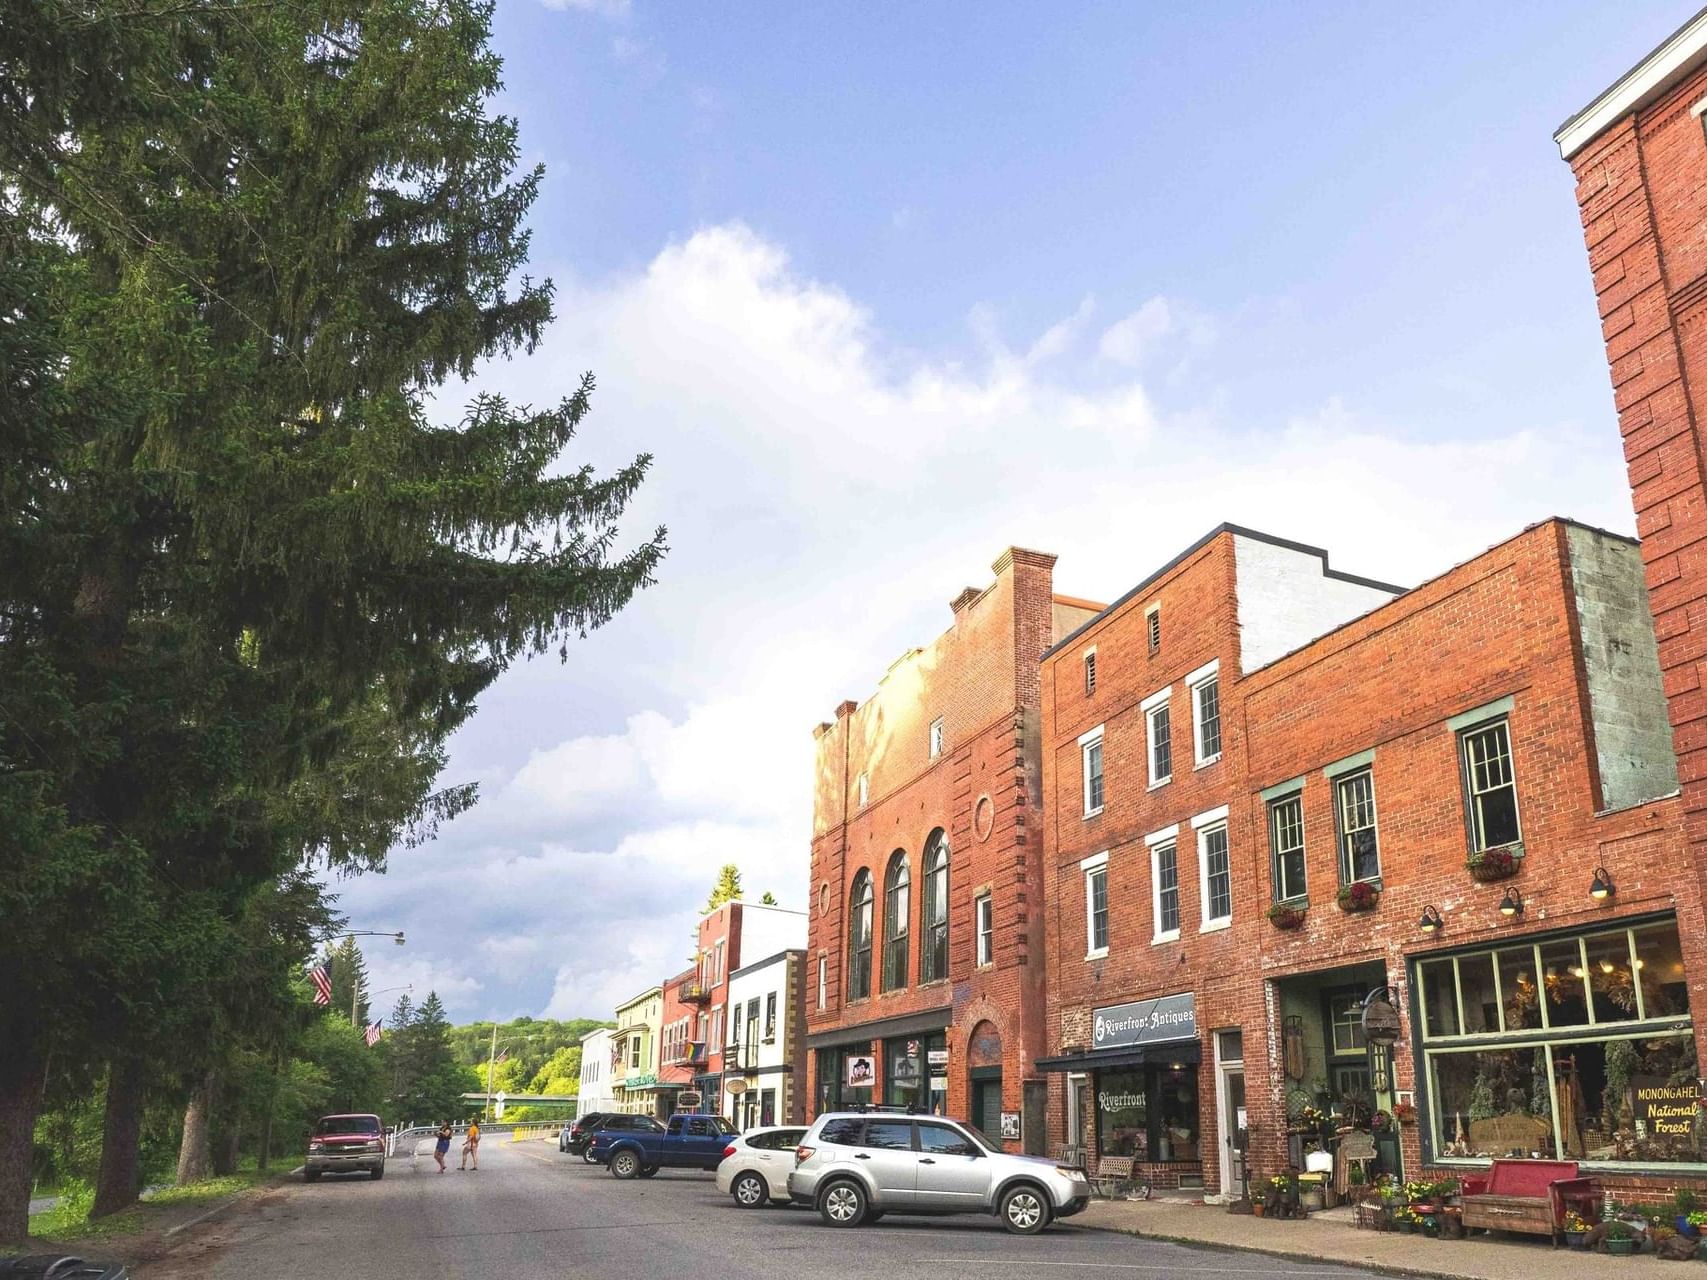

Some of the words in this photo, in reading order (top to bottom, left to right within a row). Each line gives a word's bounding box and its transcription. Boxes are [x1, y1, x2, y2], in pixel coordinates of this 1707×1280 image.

[1105, 1016, 1148, 1035] Riverfront
[1150, 1011, 1194, 1029] Antiques
[1099, 1091, 1146, 1111] Riverfront
[1638, 1087, 1701, 1100] MONONGAHEL
[1648, 1101, 1698, 1118] National
[1655, 1119, 1691, 1133] Forest
